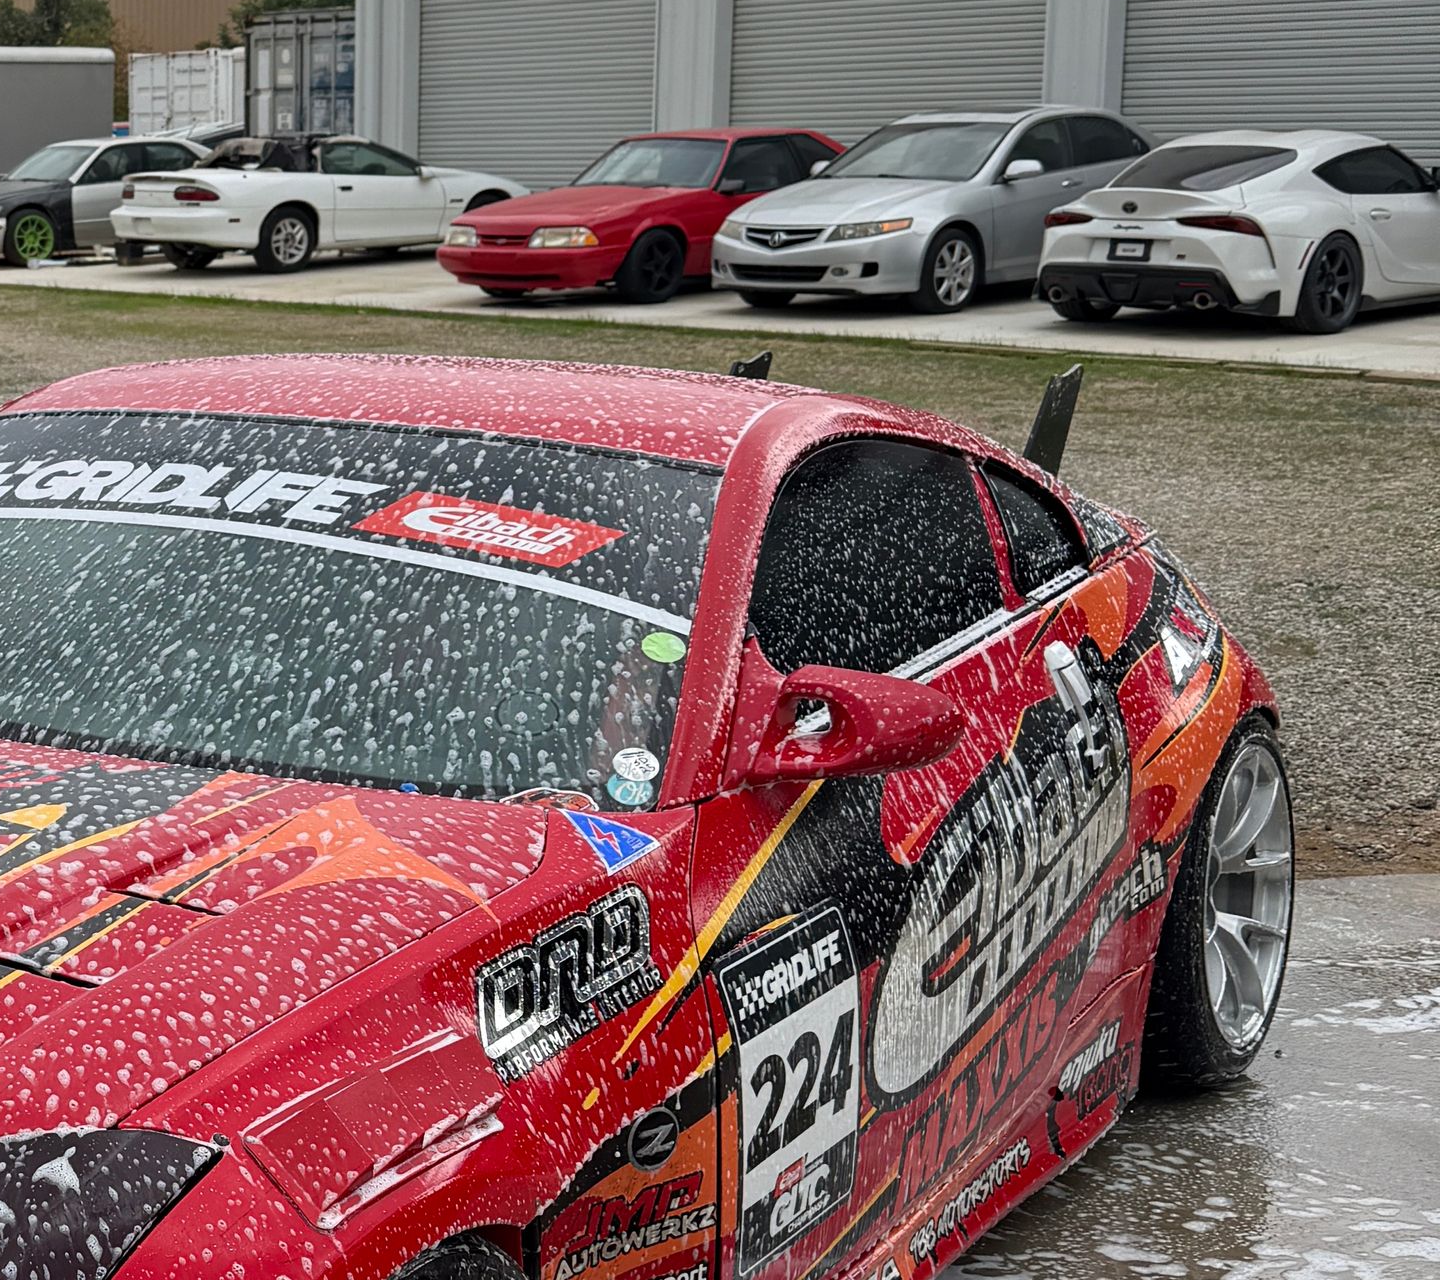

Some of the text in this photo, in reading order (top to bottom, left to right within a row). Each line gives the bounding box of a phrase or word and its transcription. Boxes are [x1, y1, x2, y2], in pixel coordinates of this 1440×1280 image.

[14, 458, 391, 524] GRIDLIFE
[401, 506, 577, 555] Eibach
[761, 929, 843, 1004] GRIDLIFE
[497, 969, 665, 1083] PERFORMANCE INTERIOR
[1057, 1020, 1120, 1094] enjuku
[746, 1008, 855, 1174] 224
[893, 970, 1059, 1217] MAXXIS
[769, 1163, 831, 1238] GLTC
[936, 1138, 1032, 1239] MOTORSPORTS
